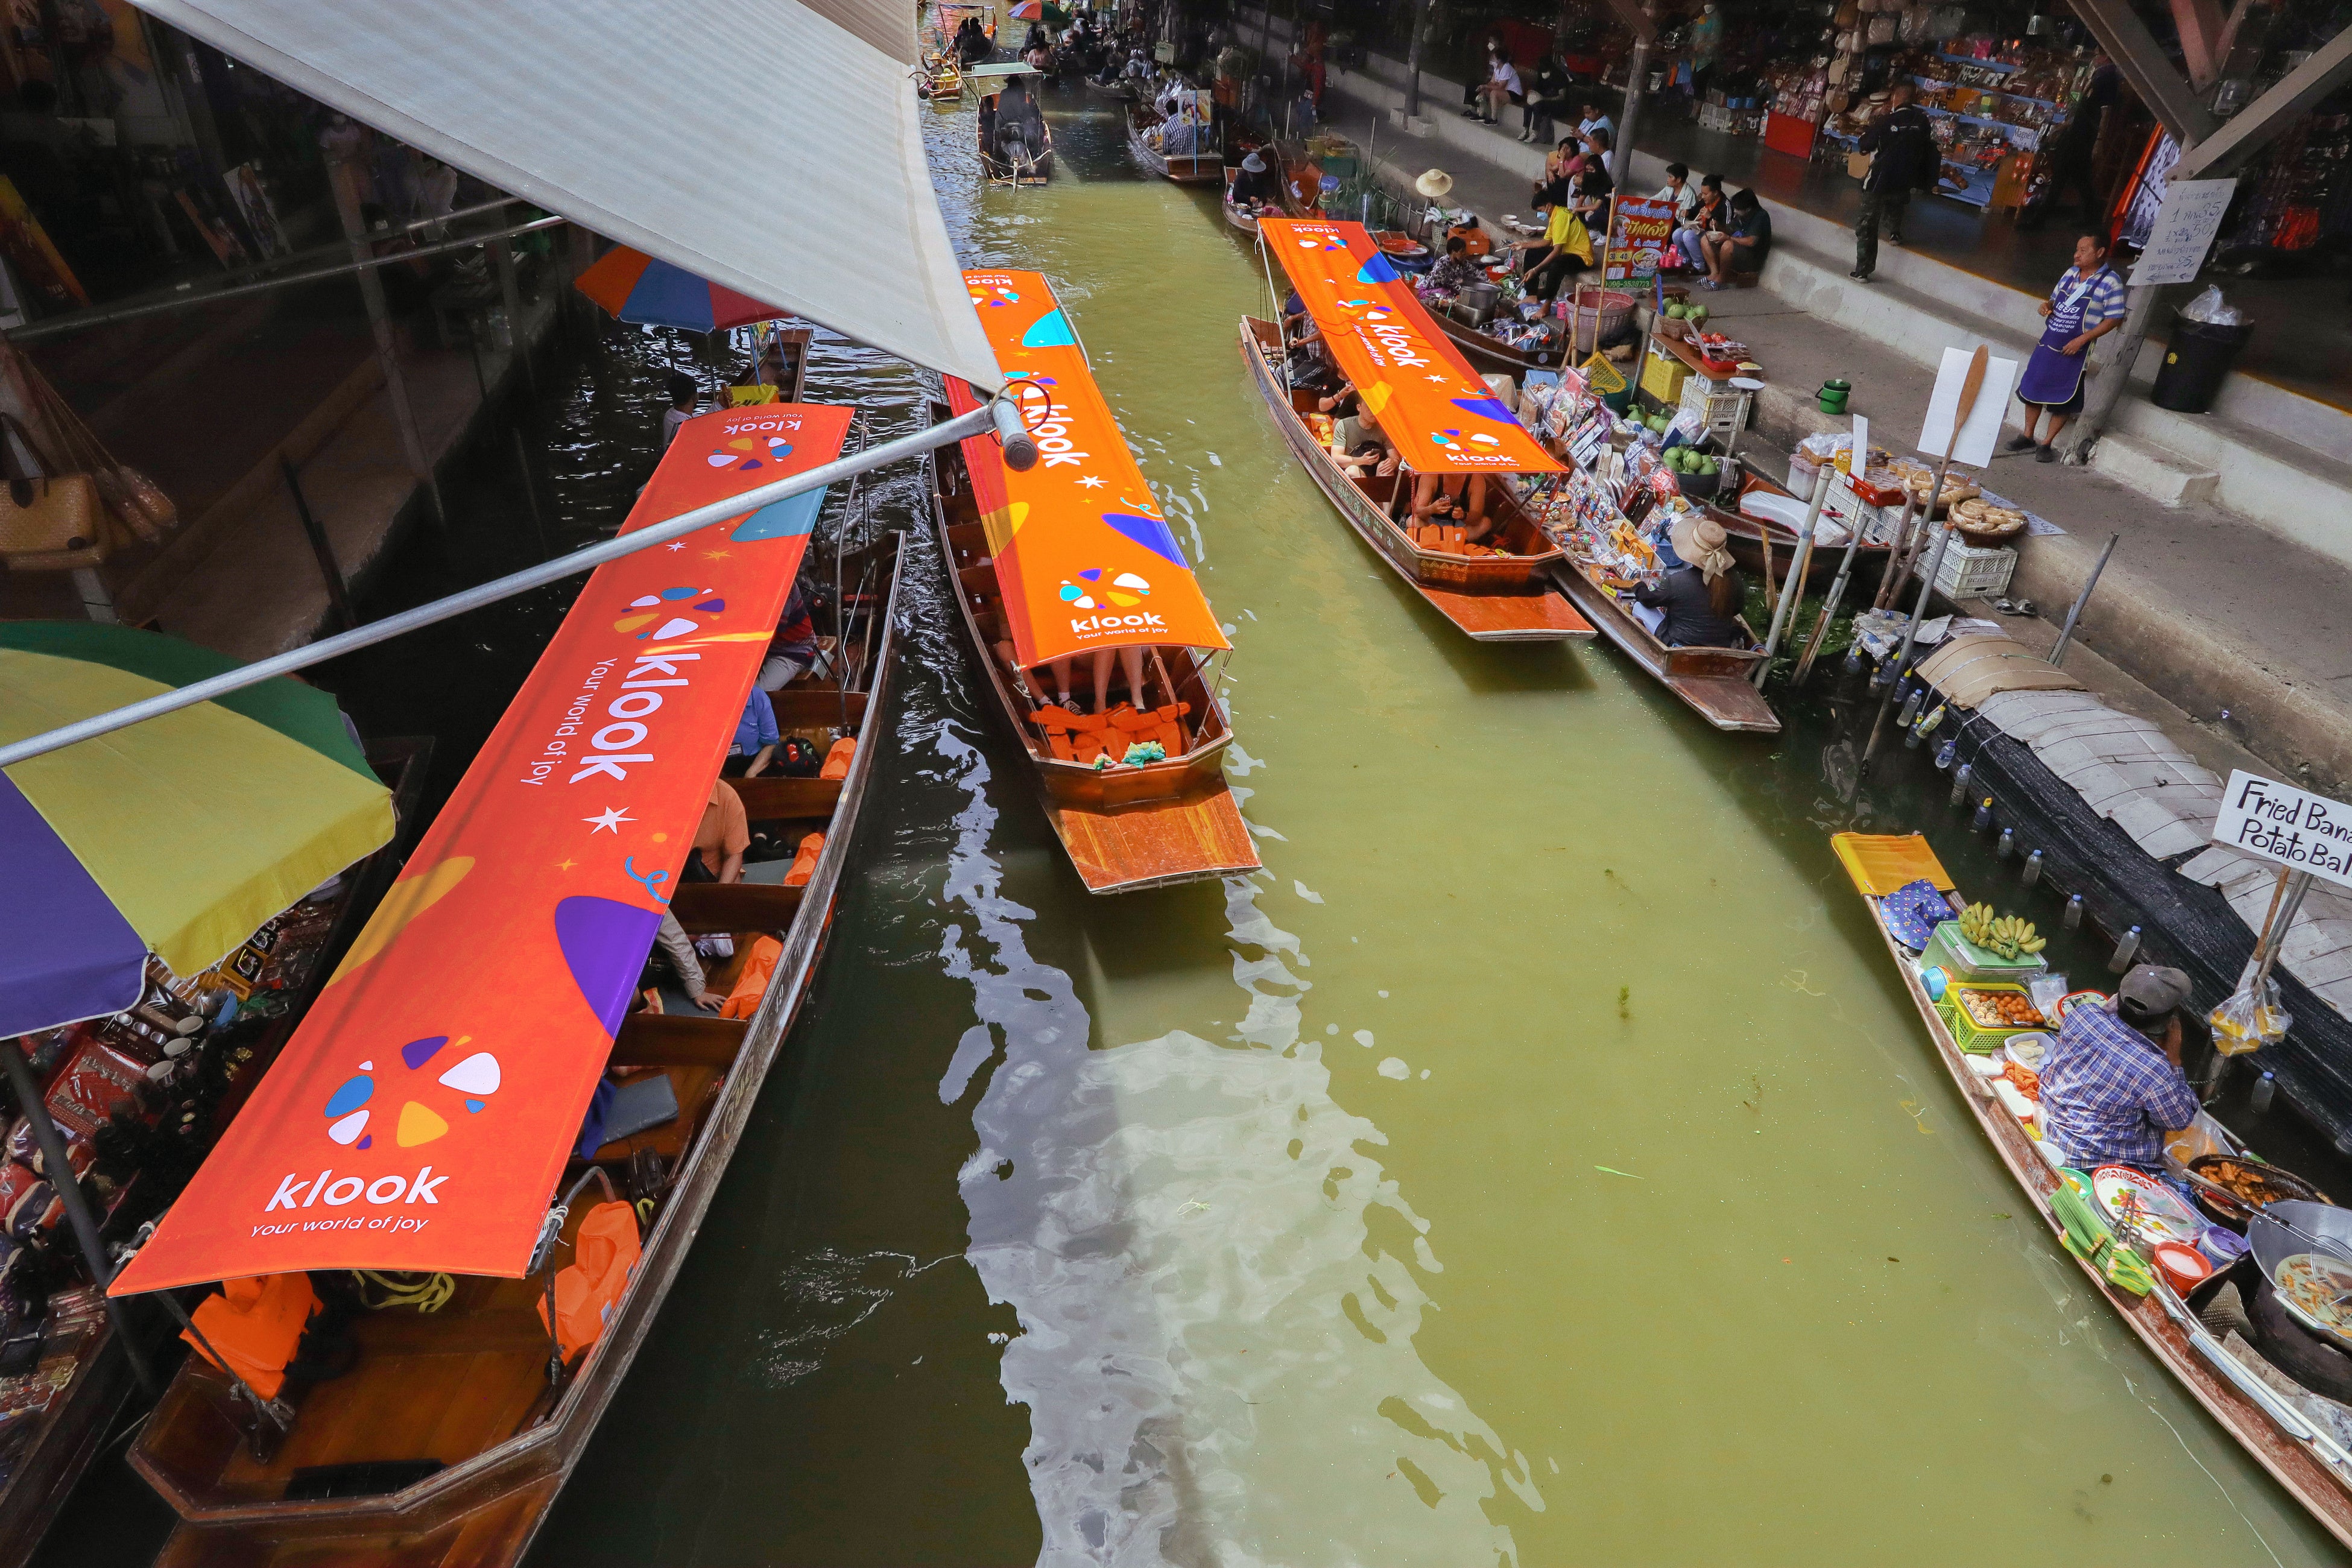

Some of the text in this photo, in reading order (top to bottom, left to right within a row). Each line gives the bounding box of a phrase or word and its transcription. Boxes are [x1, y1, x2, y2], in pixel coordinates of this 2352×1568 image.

[1370, 324, 1430, 368] klook
[722, 420, 801, 435] klook
[1024, 405, 1090, 468] klook
[1446, 454, 1517, 462] klook
[1070, 612, 1166, 633] klook
[520, 657, 618, 785] Your world of joy
[569, 653, 701, 784] klook
[2237, 780, 2303, 825] Fried
[2238, 817, 2352, 877] Potato Bal
[264, 1165, 450, 1212] klook
[302, 1216, 365, 1231] world
[368, 1216, 393, 1229] of
[389, 1216, 429, 1233] joy
